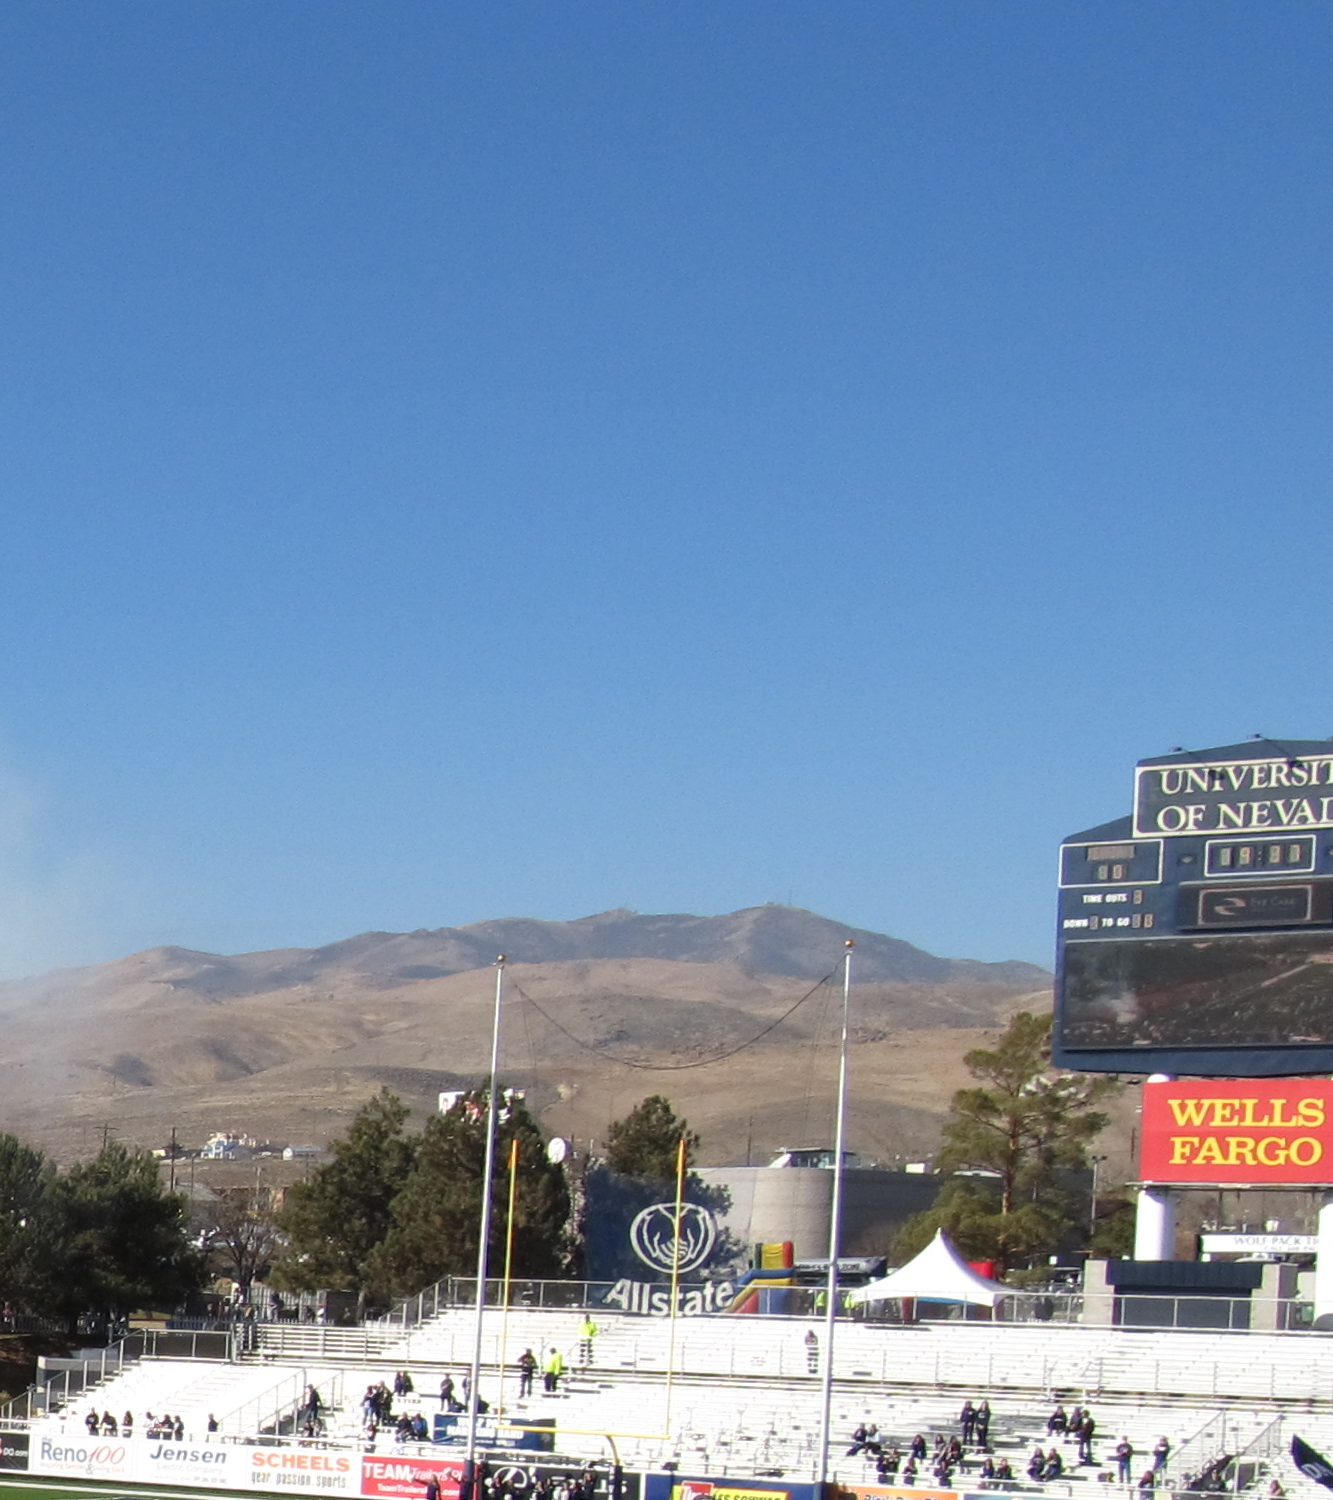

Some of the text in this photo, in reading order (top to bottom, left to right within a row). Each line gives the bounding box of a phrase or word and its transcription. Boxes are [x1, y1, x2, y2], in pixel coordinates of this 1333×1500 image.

[1159, 761, 1333, 796] UNIVERSIT
[1157, 797, 1333, 832] OF NEVAD
[1083, 892, 1128, 904] TIME OUTS
[1063, 917, 1130, 929] DOWN TO GO
[1167, 1098, 1325, 1128] WELLS
[1168, 1136, 1323, 1165] FARGO
[604, 1278, 733, 1317] Allstate
[3, 1447, 28, 1458] DQ.com
[41, 1442, 88, 1463] Reno
[149, 1444, 227, 1464] Jensen
[251, 1452, 350, 1472] SCHEELS
[363, 1462, 411, 1482] TEAM
